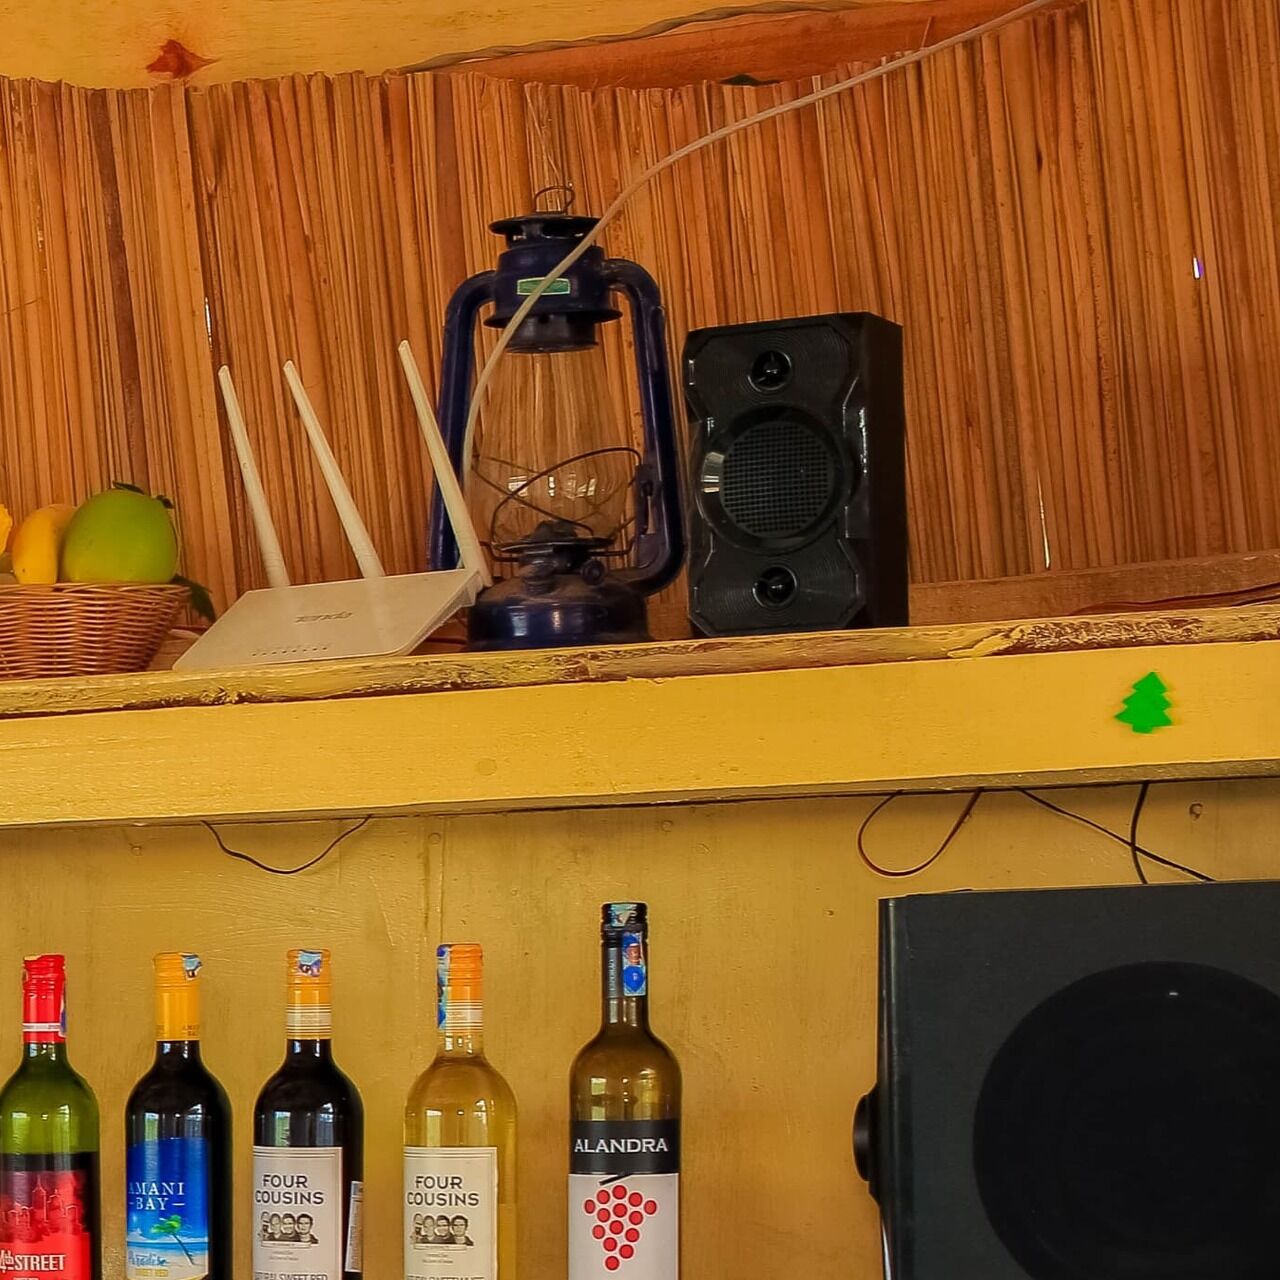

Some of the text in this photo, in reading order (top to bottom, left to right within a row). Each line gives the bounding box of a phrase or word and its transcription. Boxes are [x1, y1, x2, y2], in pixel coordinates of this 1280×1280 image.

[574, 1137, 668, 1153] ALANDRA
[128, 1182, 185, 1196] AMANI
[262, 1174, 308, 1189] FOUR
[415, 1175, 463, 1190] FOUR
[136, 1197, 169, 1211] BAY
[255, 1190, 325, 1205] COUSINS
[407, 1192, 480, 1207] COUSINS
[14, 1254, 67, 1271] STREET
